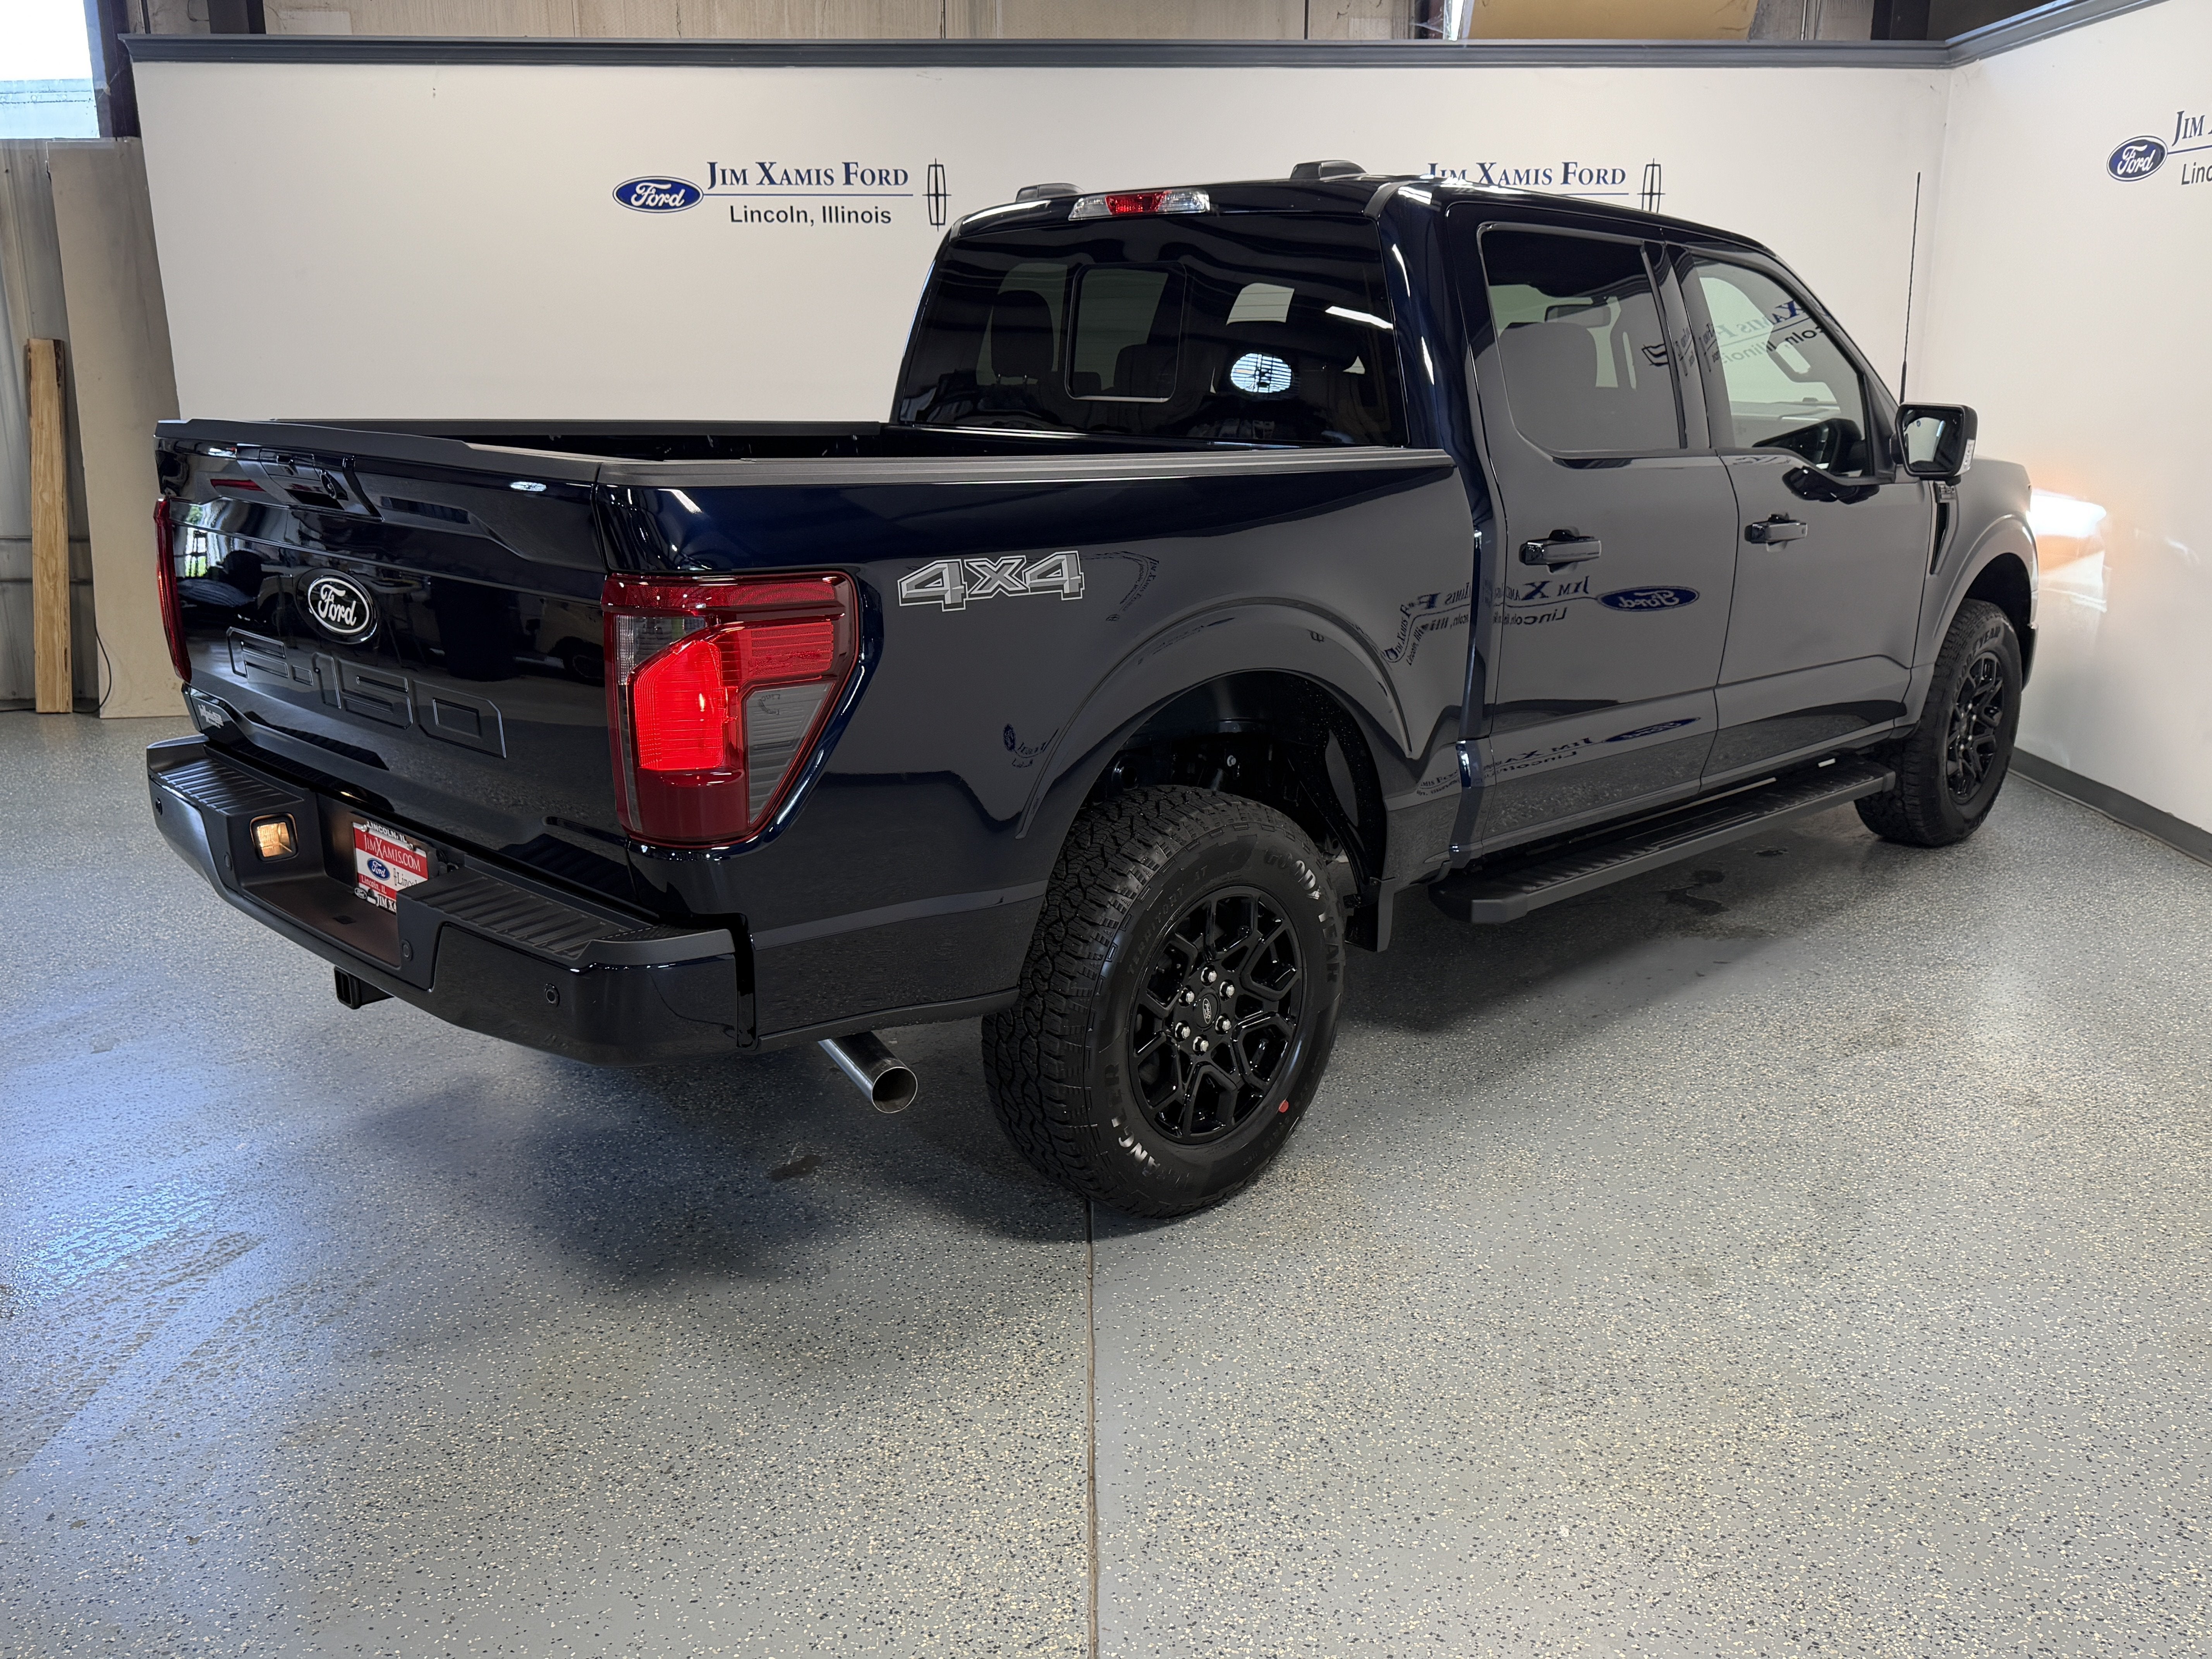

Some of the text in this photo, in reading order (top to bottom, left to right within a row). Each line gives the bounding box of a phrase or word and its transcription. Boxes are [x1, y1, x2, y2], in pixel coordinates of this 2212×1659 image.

[2172, 110, 2205, 147] JIM
[2117, 144, 2156, 175] Ford
[707, 161, 909, 190] JIM XAMIS FORD
[1476, 162, 1553, 186] XAMIS
[1561, 161, 1626, 185] FORD
[630, 182, 685, 208] Ford
[730, 205, 892, 227] Lincoln, Illinois
[318, 584, 357, 626] Ford
[226, 626, 507, 759] F-150
[366, 821, 407, 843] LINCOLN, IL
[371, 861, 386, 878] Ford
[361, 875, 387, 894] Lincoln, IL
[1104, 1063, 1177, 1184] ANGLER
